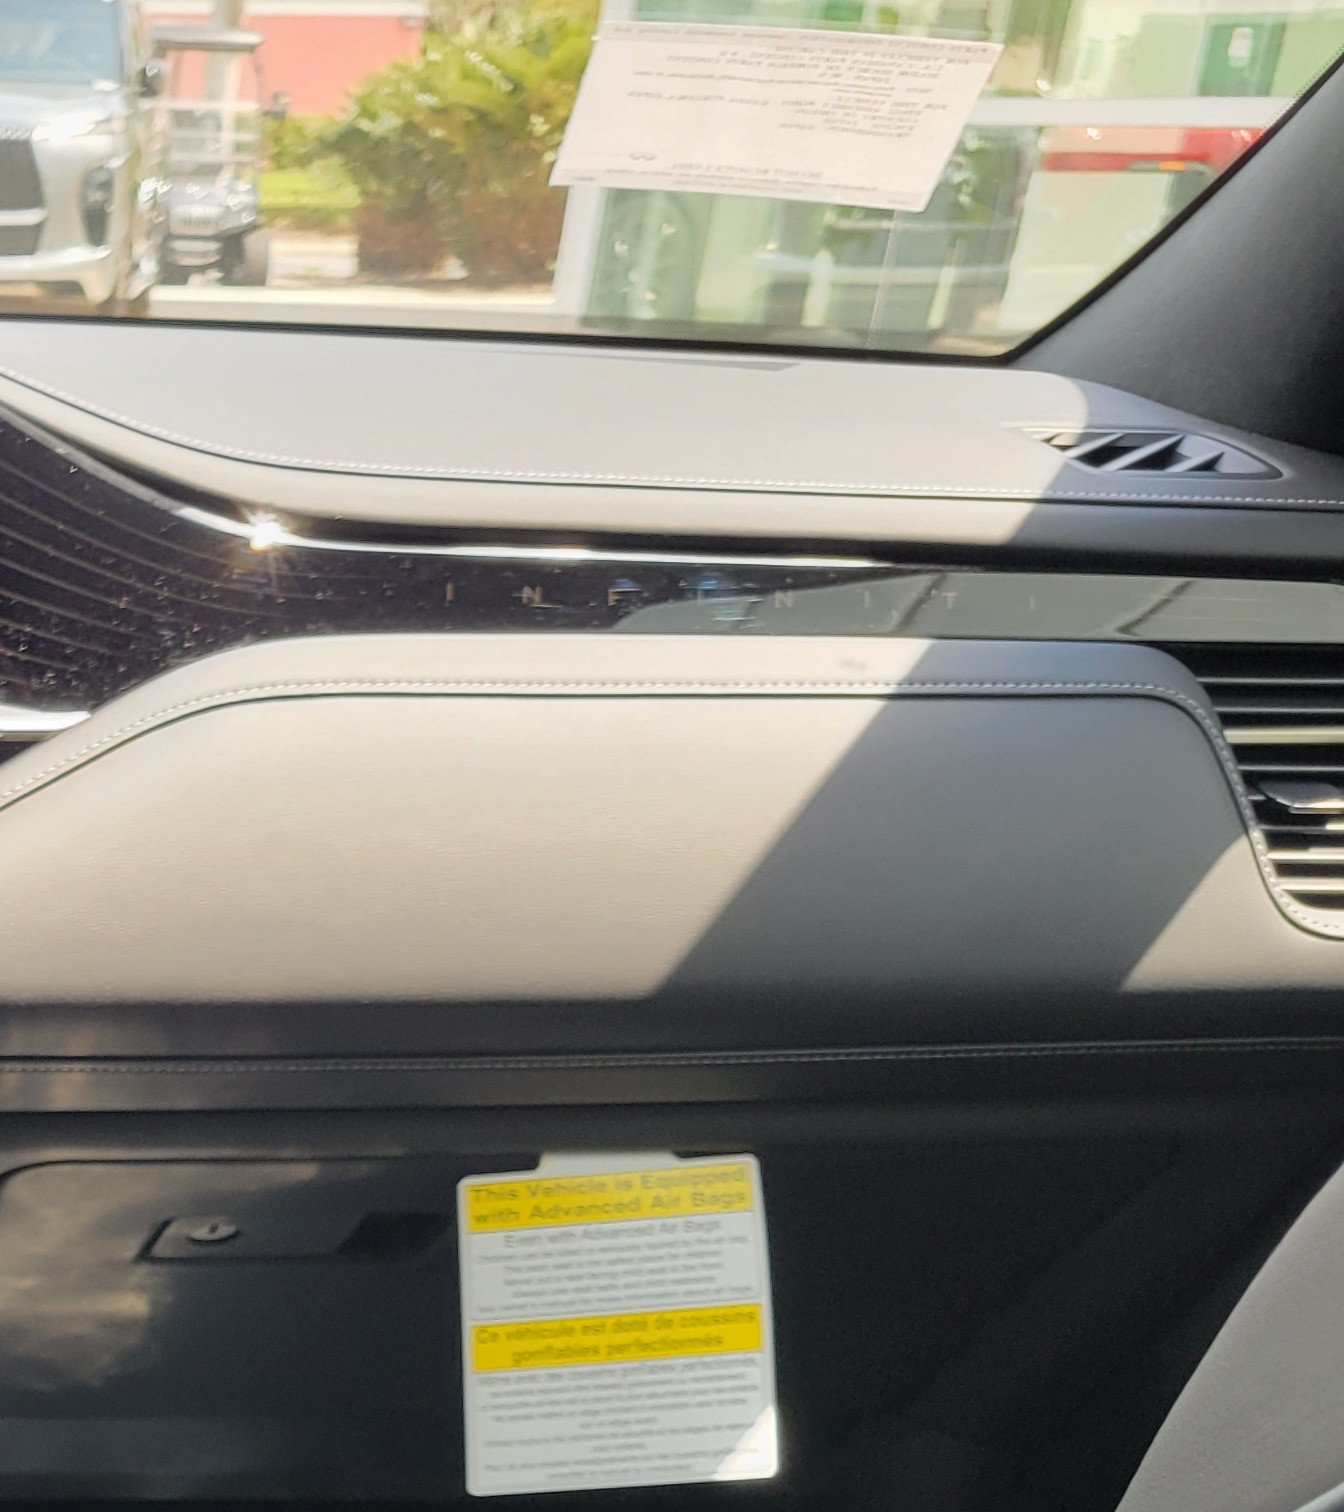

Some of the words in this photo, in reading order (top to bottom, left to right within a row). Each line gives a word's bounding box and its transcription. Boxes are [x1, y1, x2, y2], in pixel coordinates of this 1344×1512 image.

[473, 1186, 518, 1201] This
[527, 1179, 608, 1199] Vehicle
[615, 1176, 634, 1192] is
[641, 1166, 746, 1192] Equipped
[473, 1207, 519, 1224] with
[529, 1198, 640, 1219] Advanced
[650, 1194, 680, 1210] Air
[690, 1190, 747, 1211] Bags
[475, 1328, 500, 1344] Ce
[580, 1322, 607, 1337] est
[679, 1310, 757, 1329] coussins
[512, 1344, 600, 1367] gonflables
